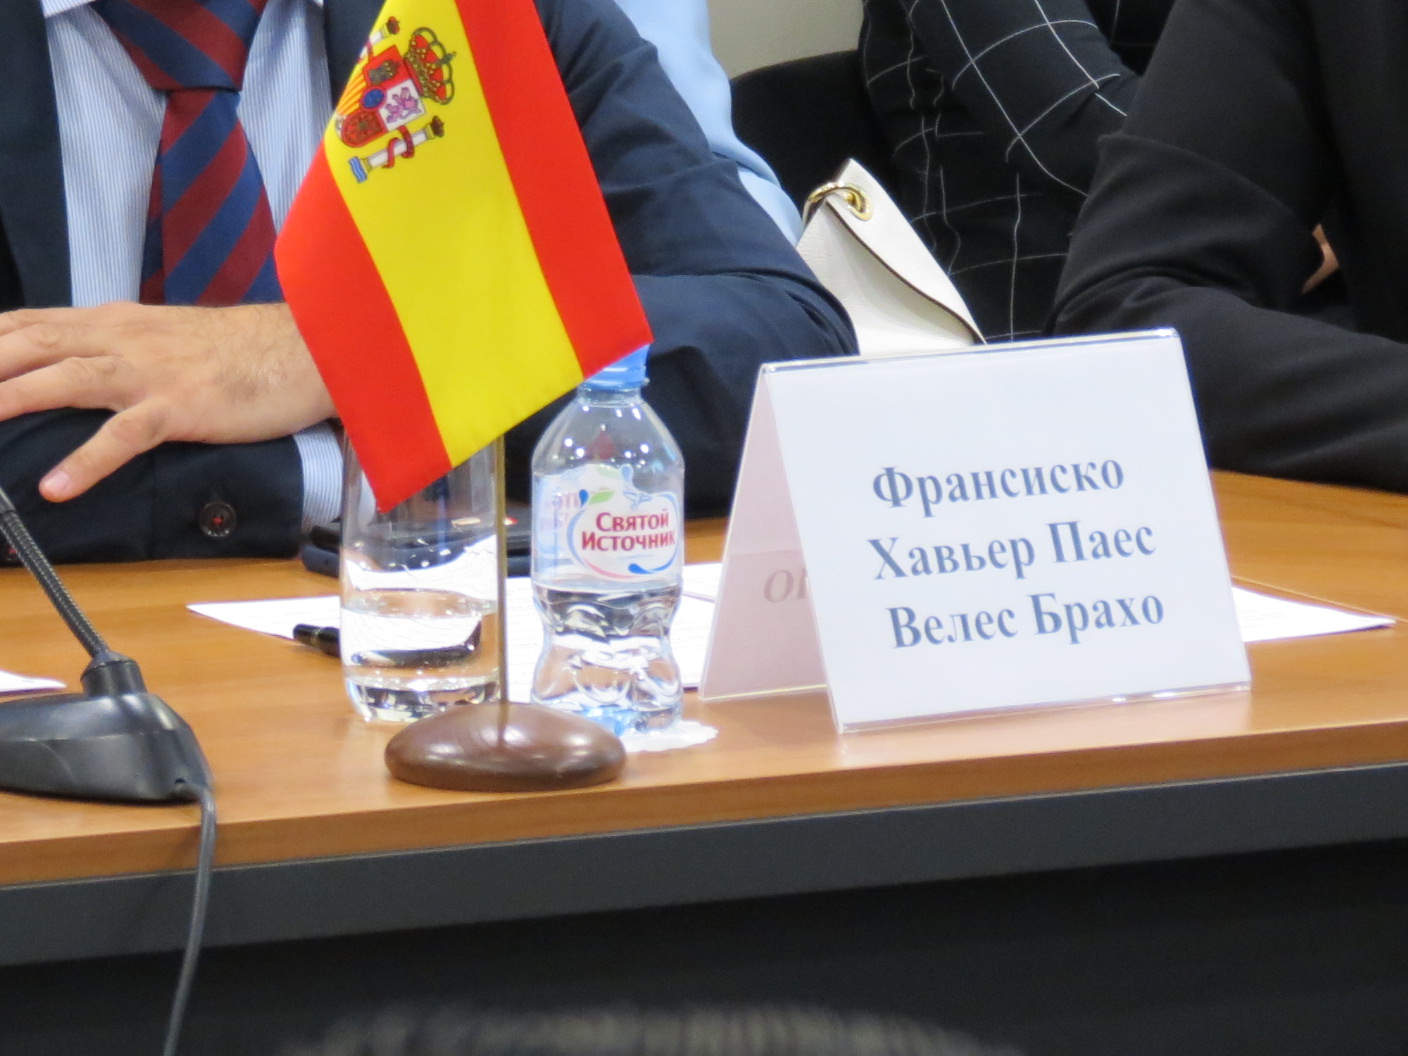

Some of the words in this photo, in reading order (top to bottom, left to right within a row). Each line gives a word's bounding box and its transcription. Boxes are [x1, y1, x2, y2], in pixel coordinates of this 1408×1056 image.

[872, 458, 1125, 518] Франсиско
[867, 536, 1036, 581] Хавьер
[1047, 520, 1155, 564] Паес
[887, 605, 1017, 649] Велес
[1029, 591, 1165, 646] Брахо
